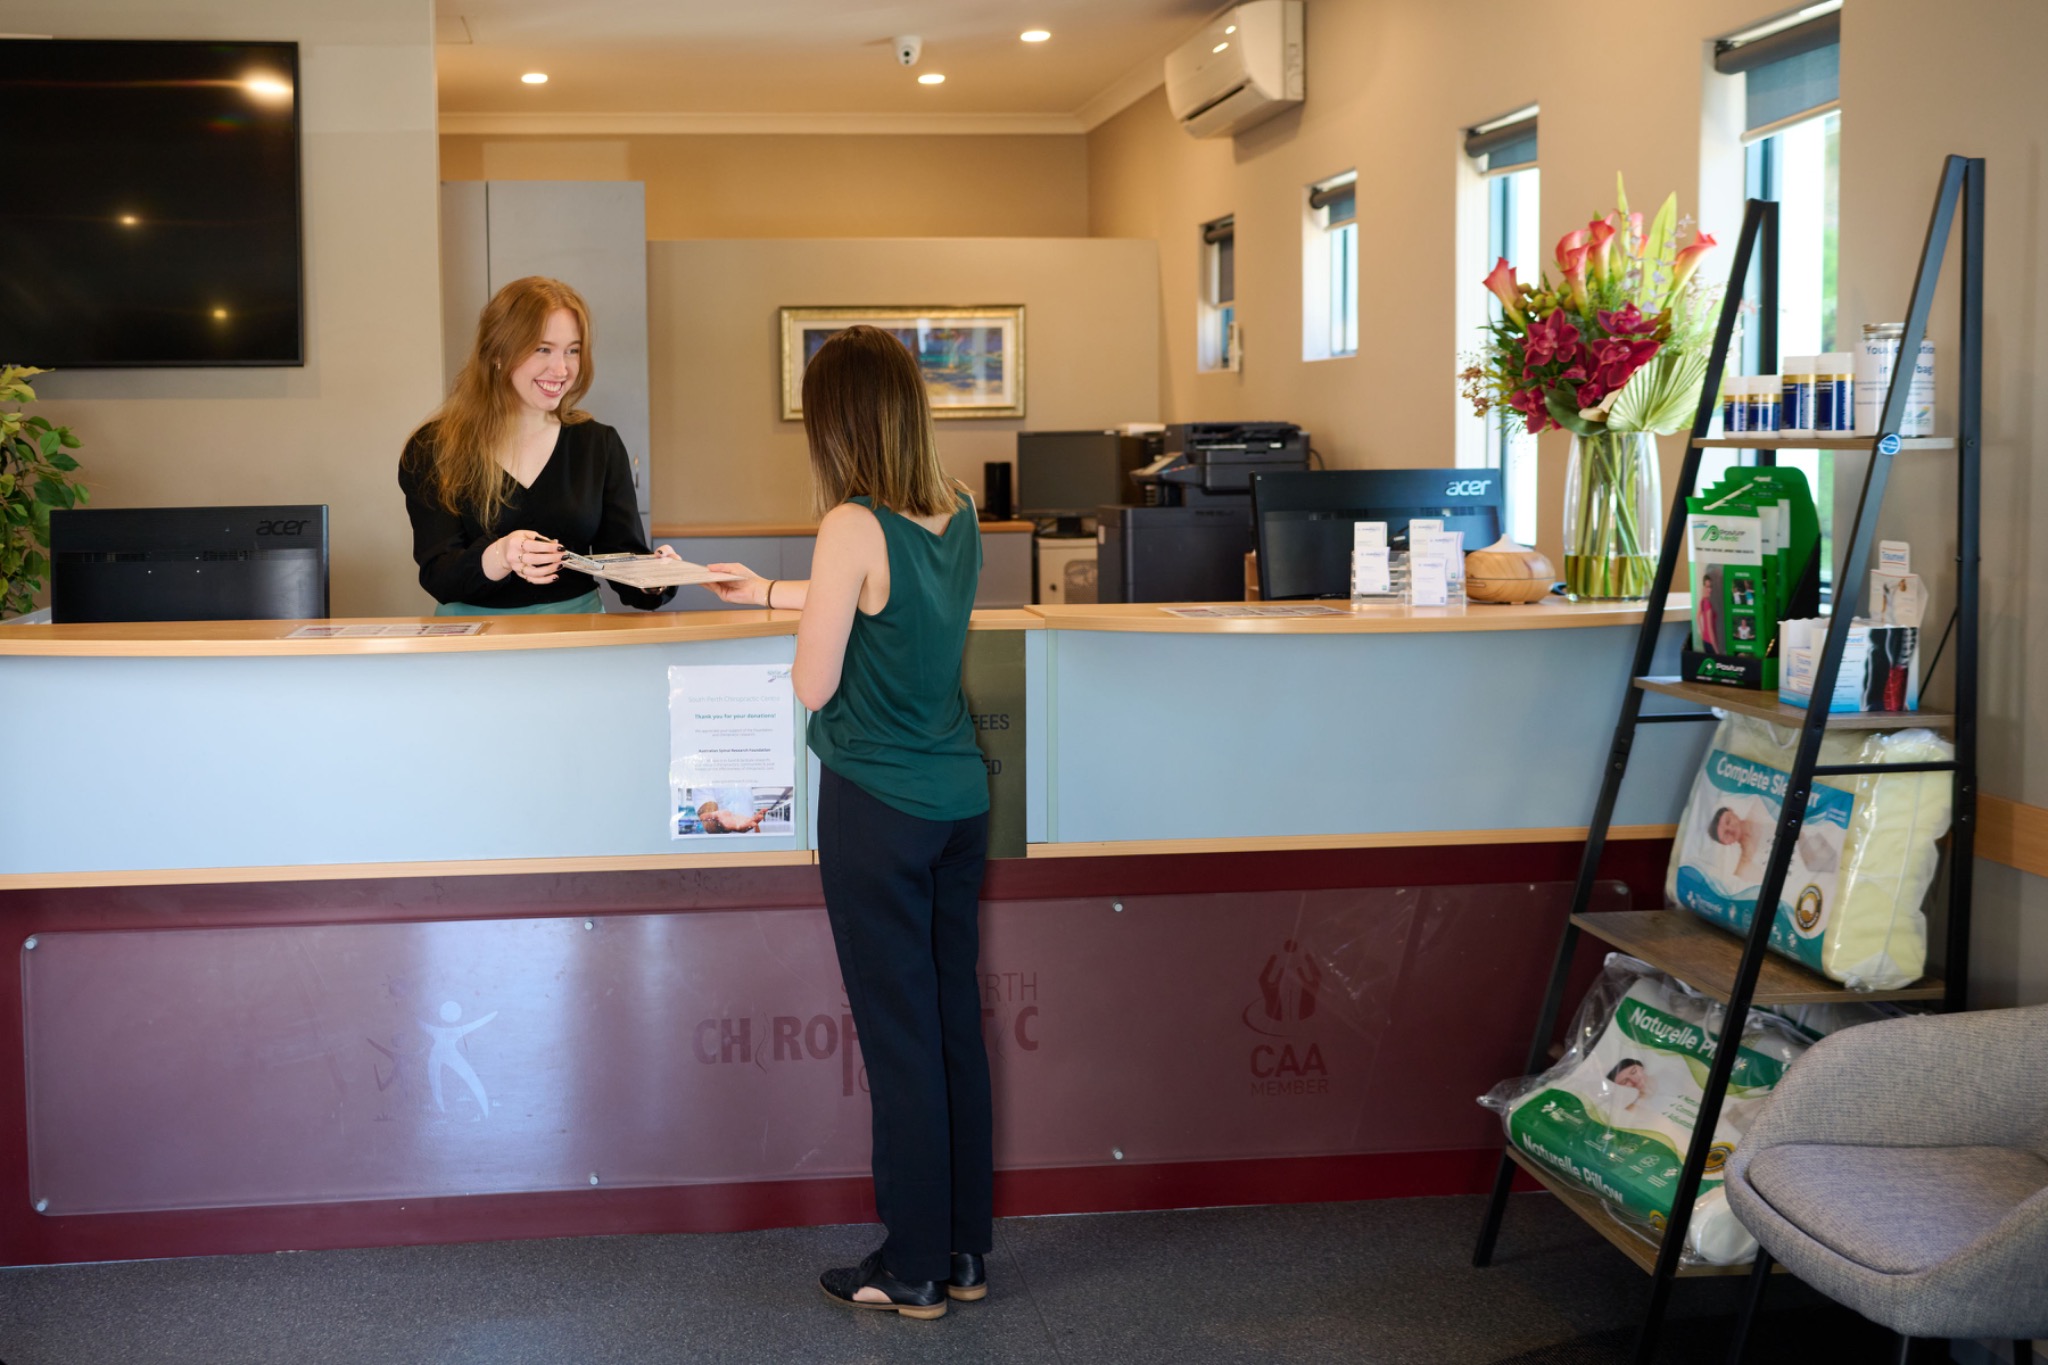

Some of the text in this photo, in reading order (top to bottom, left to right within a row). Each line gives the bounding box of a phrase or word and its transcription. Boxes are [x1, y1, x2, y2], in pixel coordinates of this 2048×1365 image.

[1446, 480, 1492, 496] acer
[256, 519, 309, 536] acer
[1717, 757, 1770, 791] Complete
[978, 971, 1037, 1002] RTH
[1631, 1007, 1697, 1050] Naturelle
[1250, 1043, 1328, 1078] CAA
[1251, 1079, 1329, 1097] MEMBER
[1522, 1132, 1624, 1203] Naturelle Pillow
